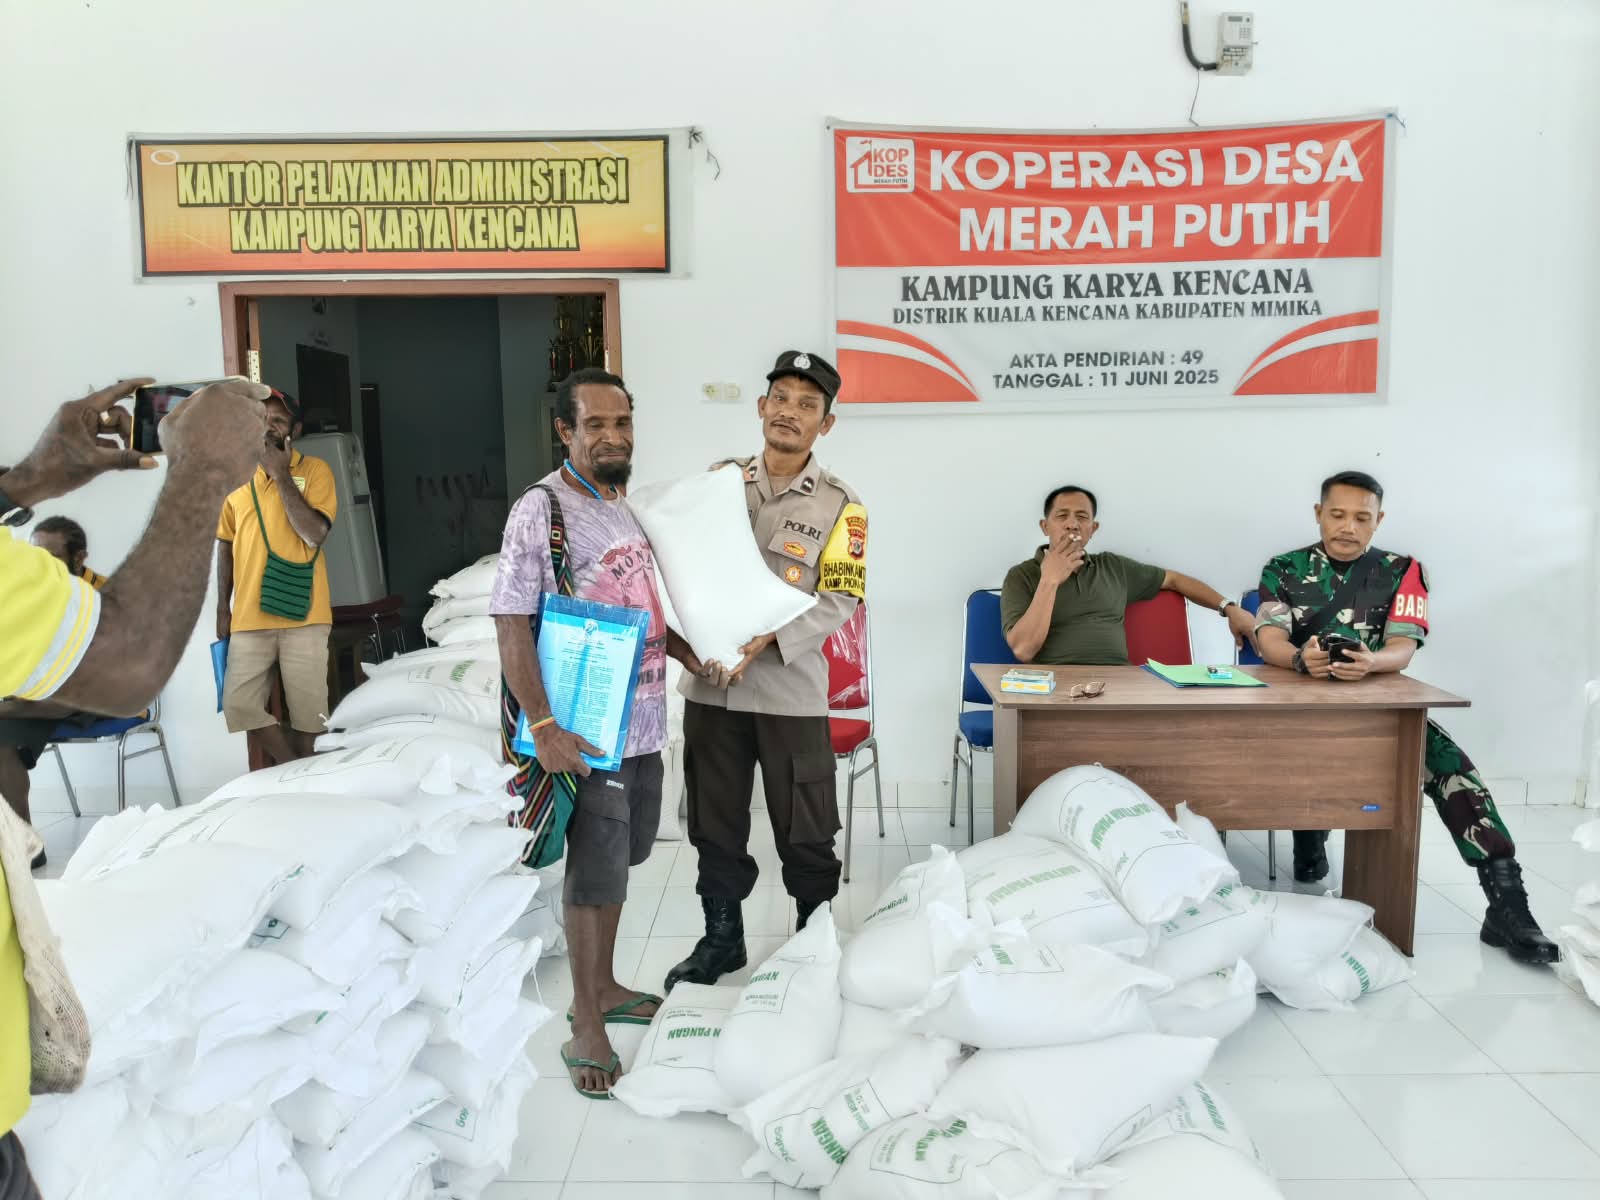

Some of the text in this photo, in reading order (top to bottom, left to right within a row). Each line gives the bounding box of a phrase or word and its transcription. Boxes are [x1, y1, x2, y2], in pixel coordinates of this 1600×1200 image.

[873, 147, 909, 163] KOP
[930, 140, 1364, 191] KOPERASI DESA
[177, 157, 630, 207] KANTOR PELAYANAN ADMINISTRASI
[873, 164, 909, 177] DES
[229, 206, 580, 253] KAMPUNG KARYA KENCANA
[960, 200, 1330, 251] MERAH PUTIH
[901, 268, 1314, 301] KAMPUNG KARYA KENCANA
[892, 299, 1322, 324] DISTRIK KUALA KENCANA KABUPATEN MIMIKA
[1009, 354, 1057, 369] AKTA
[1063, 351, 1165, 368] PENDIRIAN
[1181, 350, 1204, 365] 49
[992, 373, 1083, 389] TANGGAL
[1101, 371, 1117, 386] 11
[1125, 370, 1168, 386] JUNI
[1174, 369, 1219, 385] 2025
[783, 519, 822, 541] POLRI
